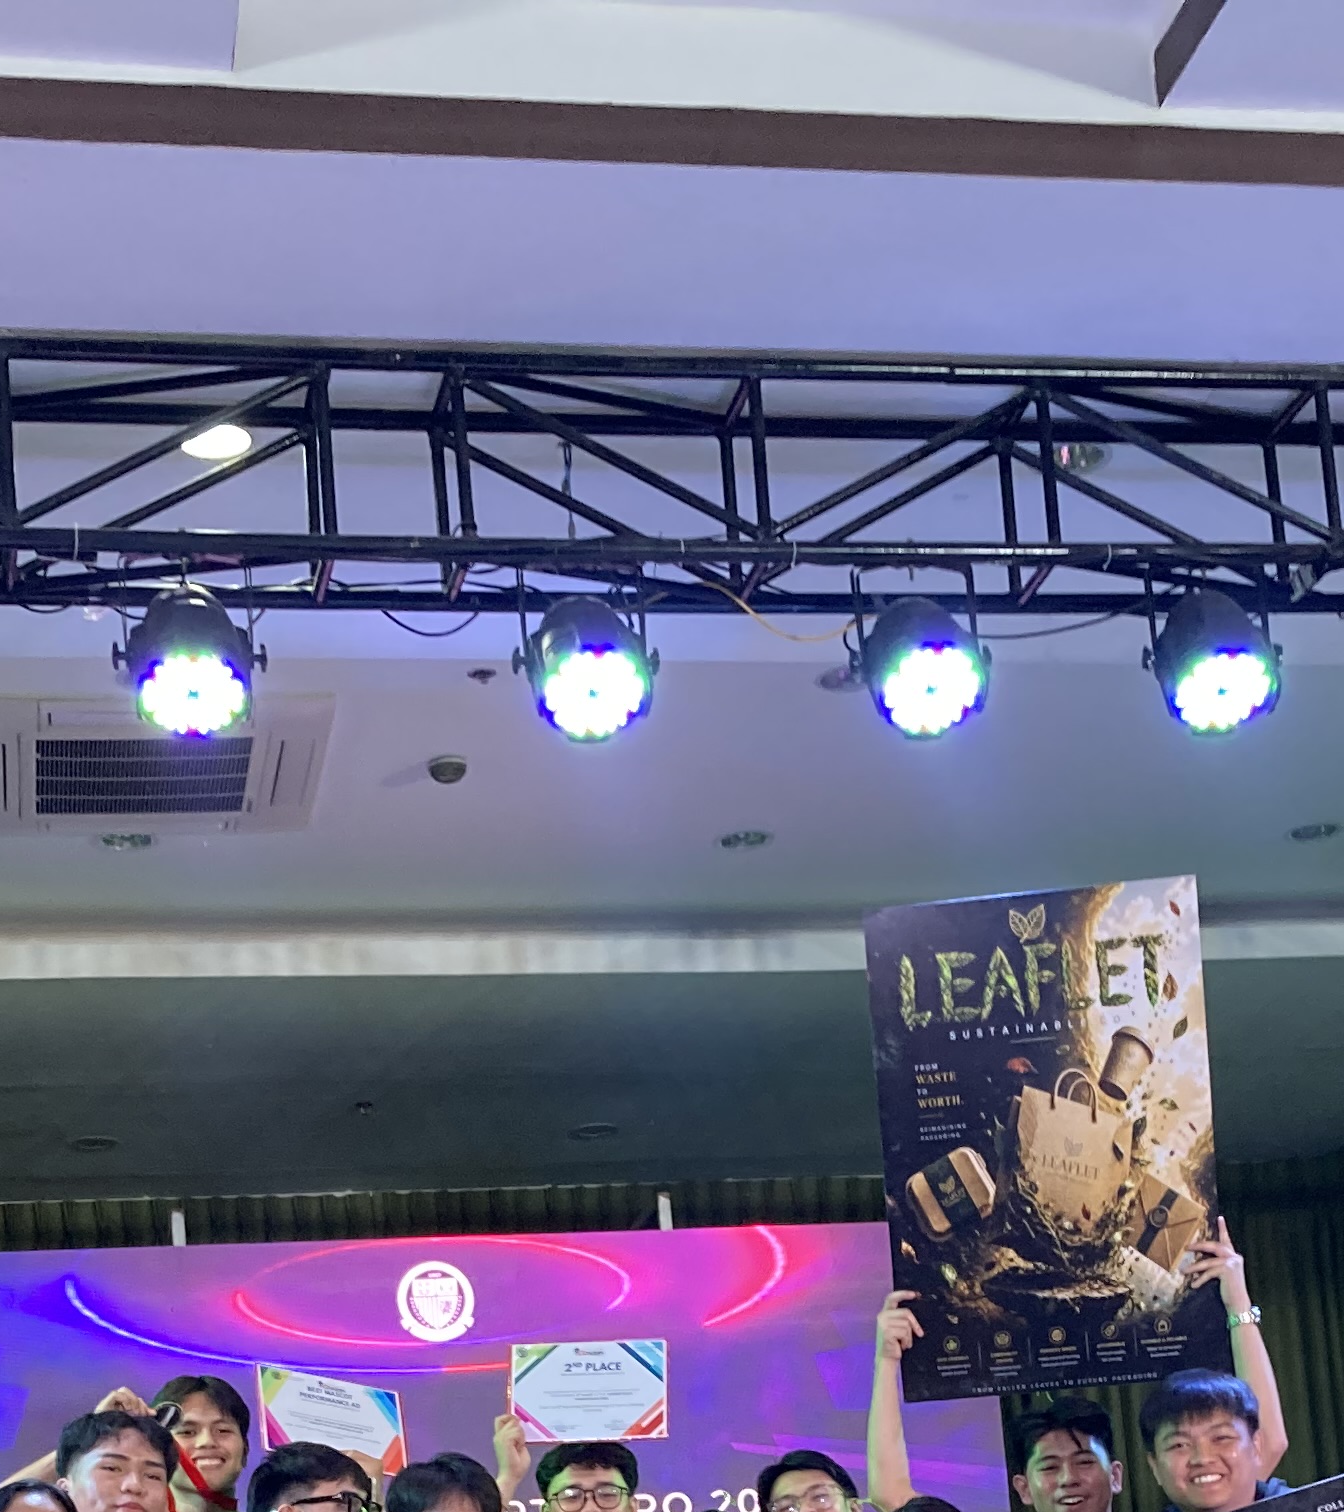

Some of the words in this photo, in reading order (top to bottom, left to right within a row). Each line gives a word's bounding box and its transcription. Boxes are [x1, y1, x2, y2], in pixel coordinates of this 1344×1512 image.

[898, 934, 1164, 1031] LEAFLET
[914, 1063, 938, 1072] FROM
[915, 1071, 956, 1084] WASTE
[585, 1361, 621, 1372] PLACE
